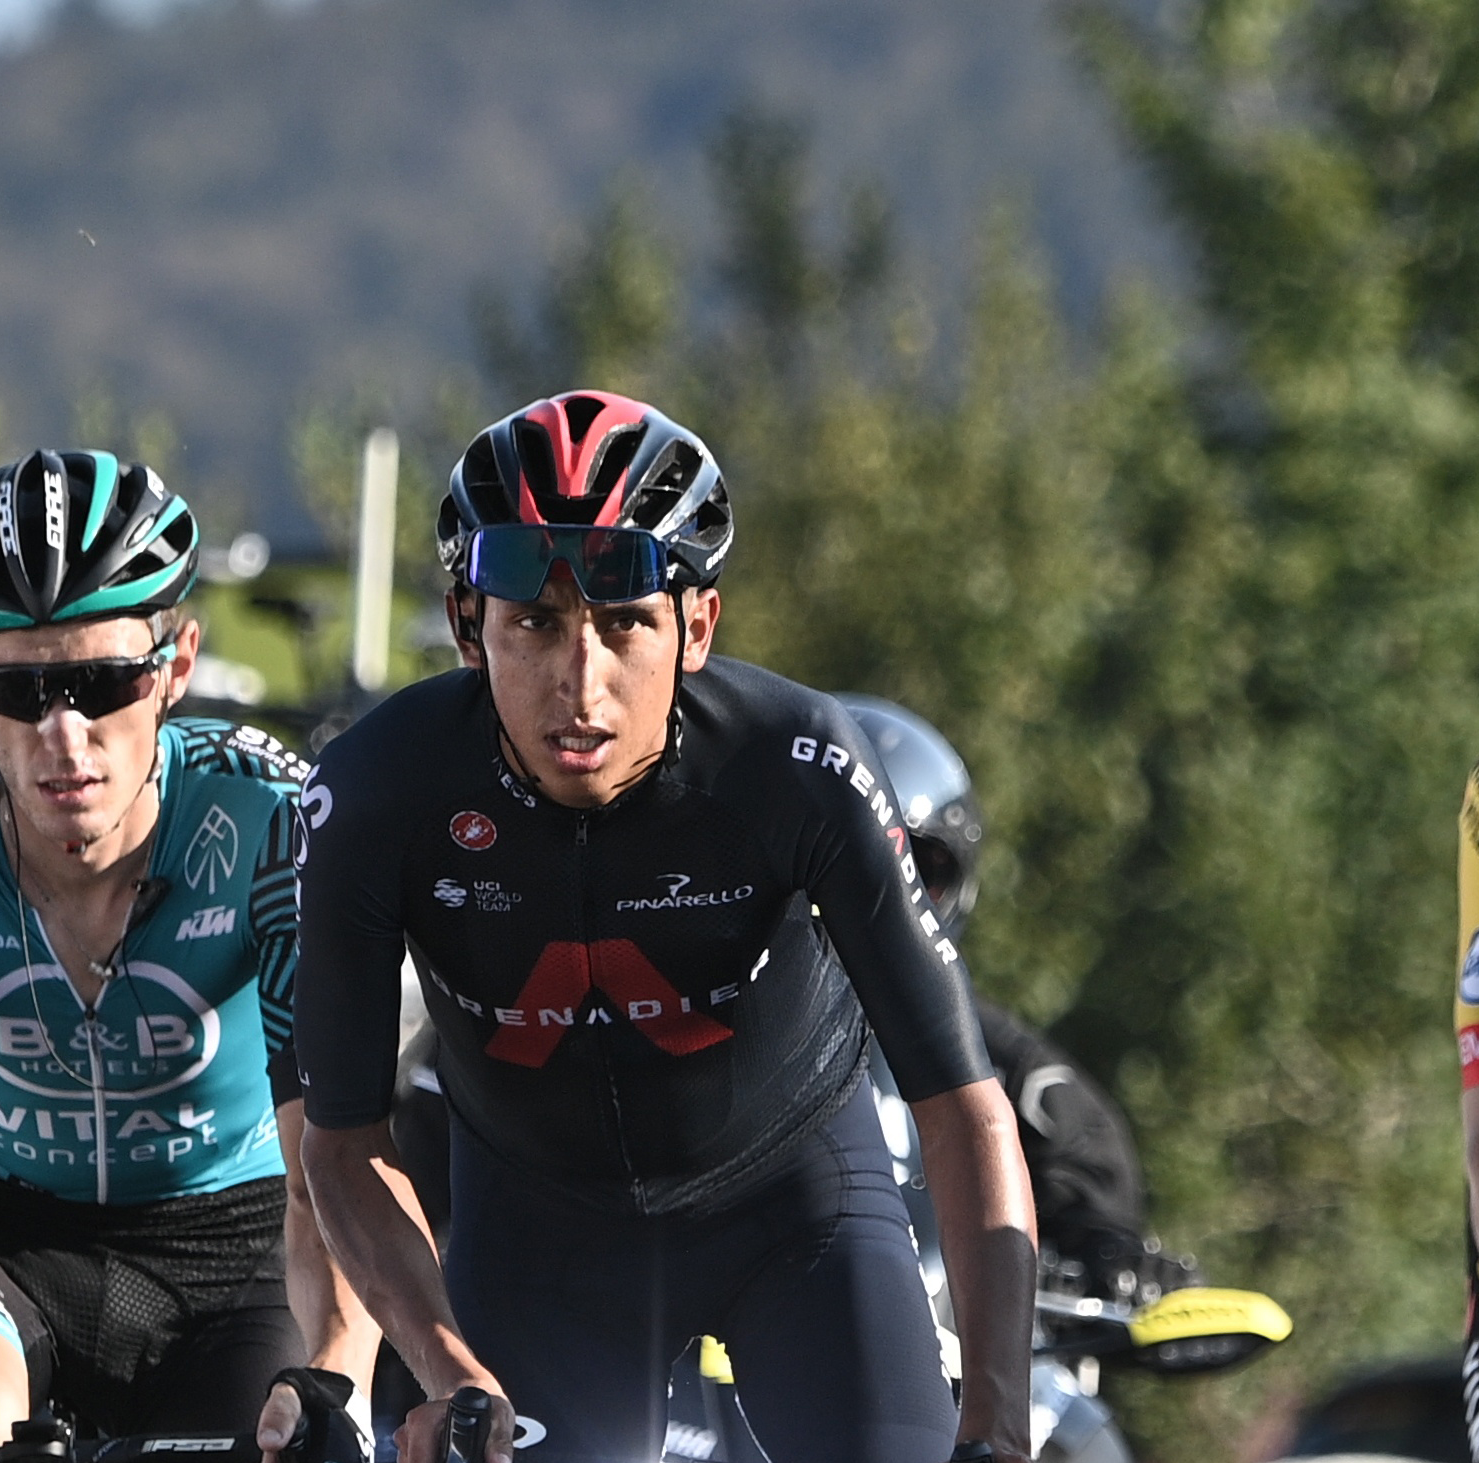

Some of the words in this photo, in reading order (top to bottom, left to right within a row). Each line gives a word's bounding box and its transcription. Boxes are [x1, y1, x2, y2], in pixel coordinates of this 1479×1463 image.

[791, 736, 958, 965] GRENADIER
[474, 881, 500, 890] UCI
[475, 891, 522, 902] WORLD
[617, 885, 754, 911] PINARELLO
[477, 901, 510, 912] TEAM
[175, 906, 237, 942] KTM
[136, 1015, 195, 1057] B
